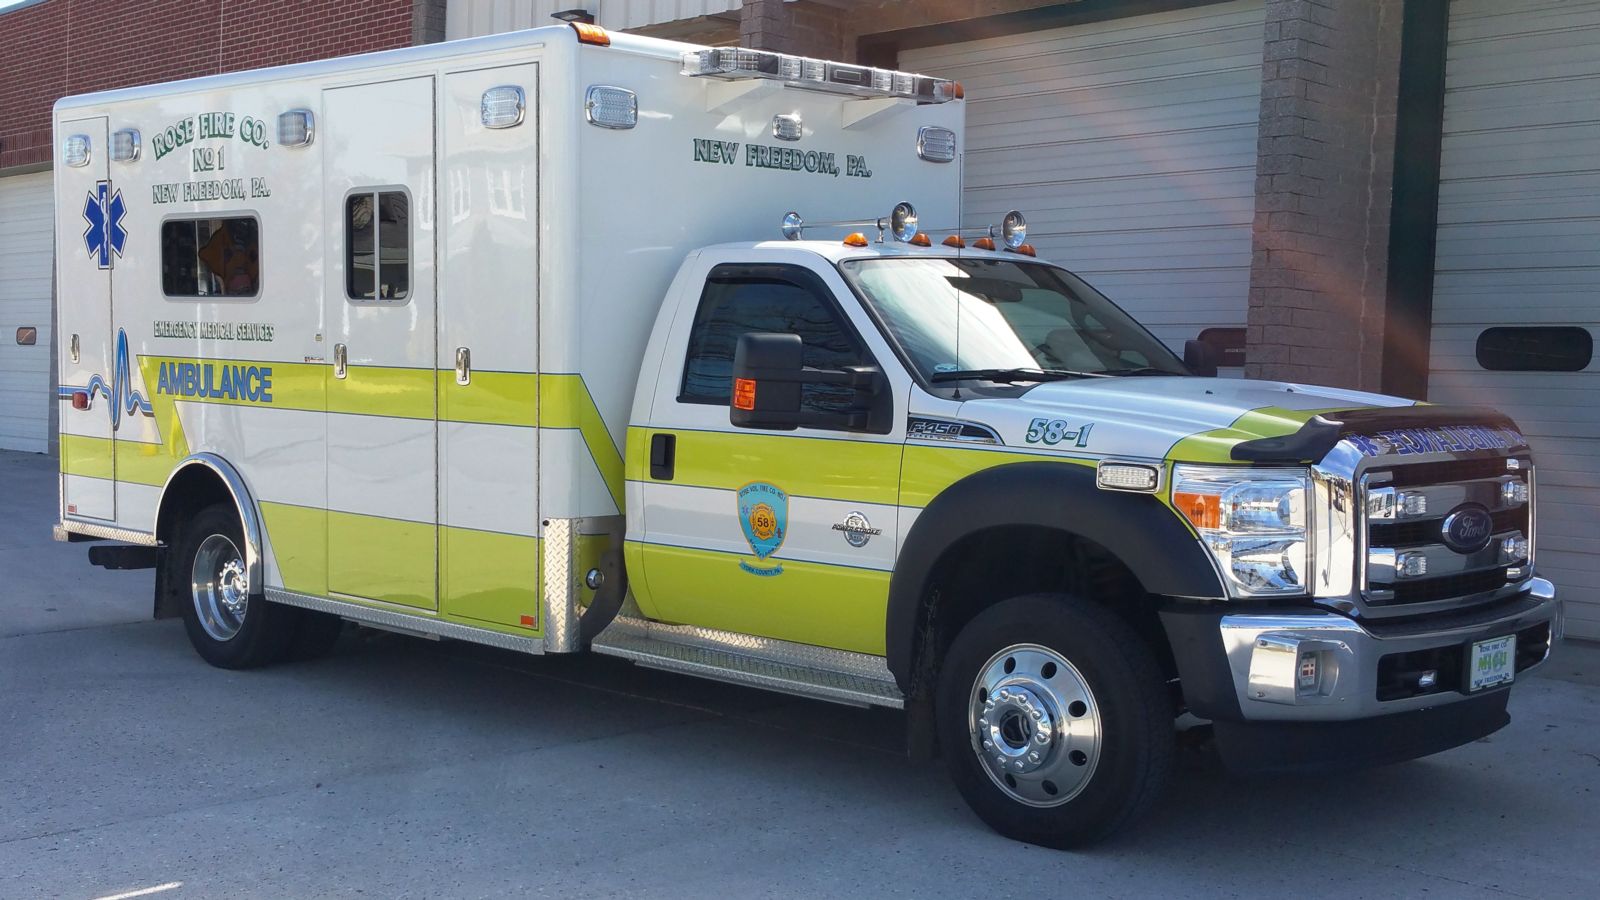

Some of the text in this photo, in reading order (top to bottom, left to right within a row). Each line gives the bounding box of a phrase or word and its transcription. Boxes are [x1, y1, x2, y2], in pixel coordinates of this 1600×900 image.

[152, 112, 270, 160] ROSE FIRE CO.
[693, 138, 872, 177] NEW FREEDOM, PA.
[152, 177, 272, 204] NEW FREEDOM, PA.
[154, 321, 274, 341] EMERGENCY MEDICAL SERVICES
[157, 361, 272, 402] AMBULANCE
[1026, 417, 1094, 447] 58-1
[757, 517, 769, 528] 58
[1459, 516, 1486, 538] Ford
